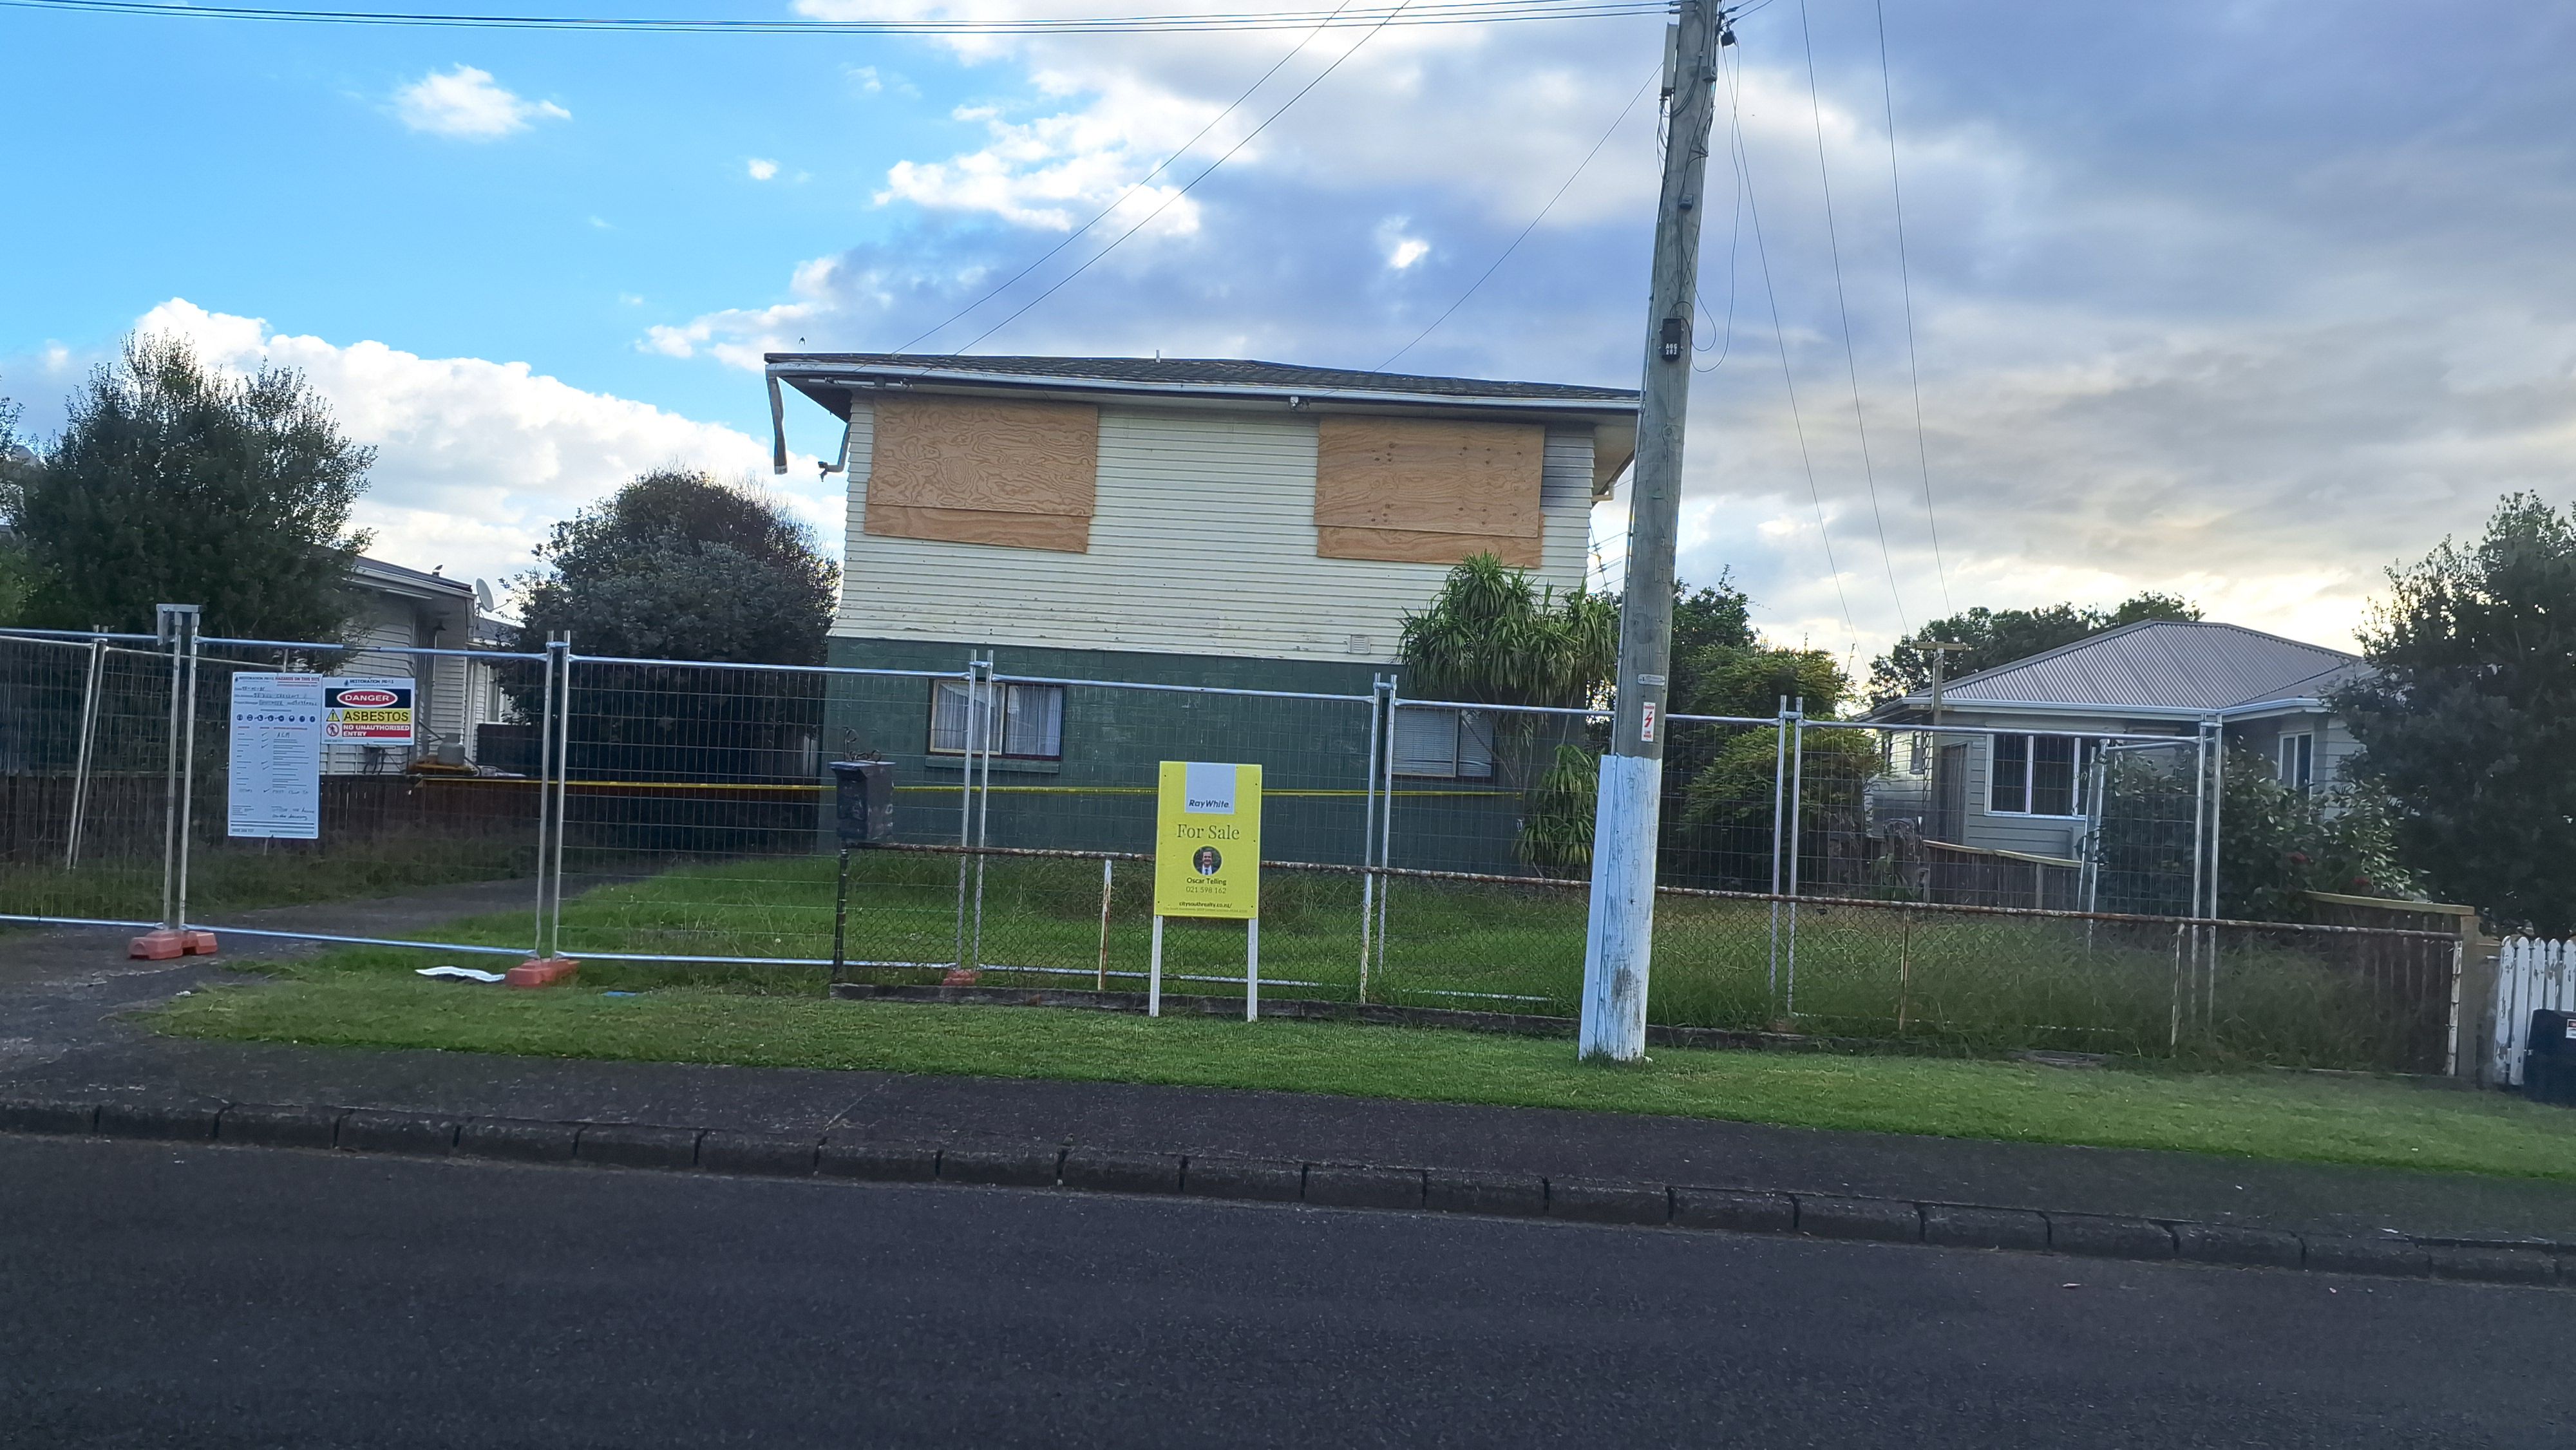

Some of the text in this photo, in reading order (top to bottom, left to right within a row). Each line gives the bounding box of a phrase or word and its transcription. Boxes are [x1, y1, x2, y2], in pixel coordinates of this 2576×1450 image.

[343, 711, 409, 722] ASBESTOS
[1177, 824, 1240, 840] For Sale
[1206, 878, 1227, 886] Telling
